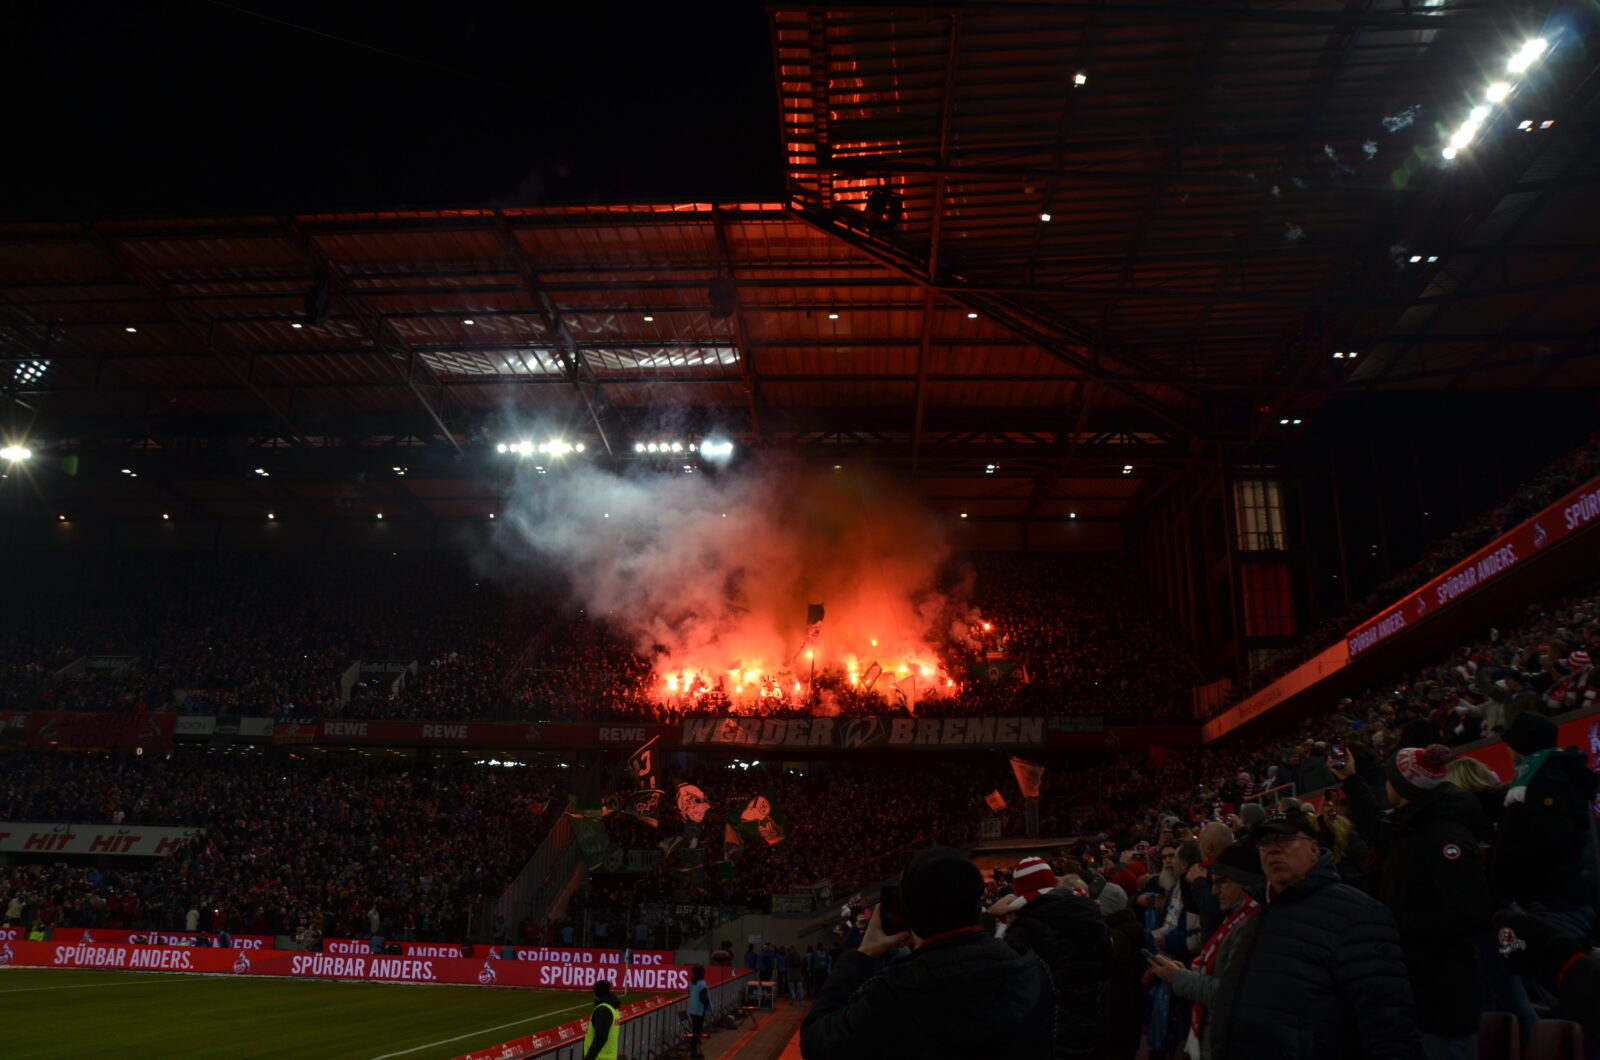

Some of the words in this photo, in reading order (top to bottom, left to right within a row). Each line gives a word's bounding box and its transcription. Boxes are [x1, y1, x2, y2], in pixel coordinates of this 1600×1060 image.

[1564, 489, 1600, 530] SPÜR
[1436, 566, 1477, 605] SPÜRBAR
[1477, 543, 1518, 583] ANDERS.
[324, 722, 368, 736] REWE
[422, 724, 468, 739] REWE
[599, 727, 646, 742] REWE
[682, 717, 834, 746] WERDER
[888, 716, 1045, 745] BREMEN
[24, 833, 76, 850] HIT
[89, 835, 141, 852] HIT
[54, 943, 126, 967] SPÜRBAR
[129, 949, 194, 969] ANDERS.
[291, 953, 364, 977] SPÜRBAR
[370, 960, 437, 980] ANDERS.
[540, 963, 617, 987] SPÜRBAR
